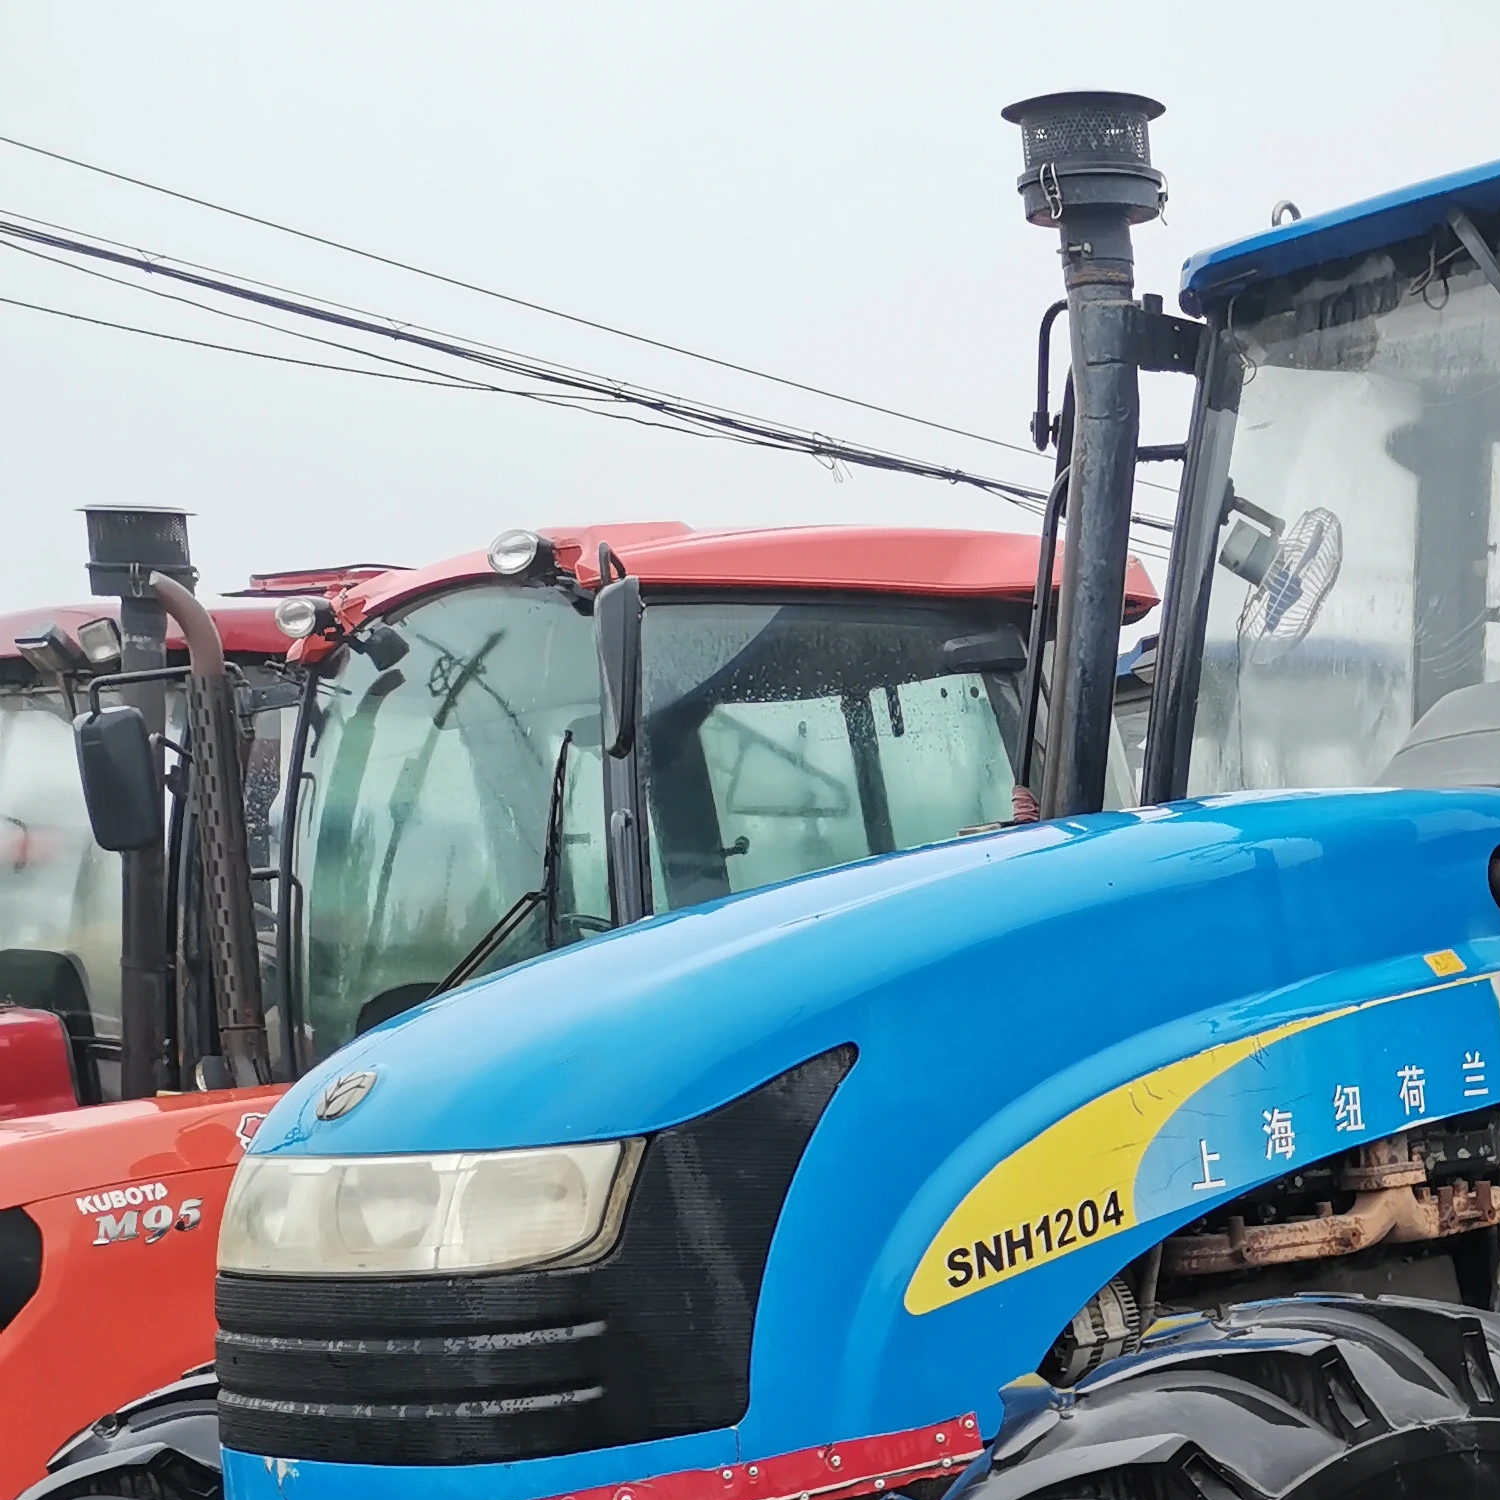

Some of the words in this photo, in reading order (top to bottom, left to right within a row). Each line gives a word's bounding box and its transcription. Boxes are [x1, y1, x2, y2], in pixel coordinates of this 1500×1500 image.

[1192, 1051, 1490, 1192] 上海纽荷兰
[76, 1182, 168, 1215] KUBOTA
[92, 1198, 204, 1246] M95
[946, 1189, 1126, 1289] SNH1204
